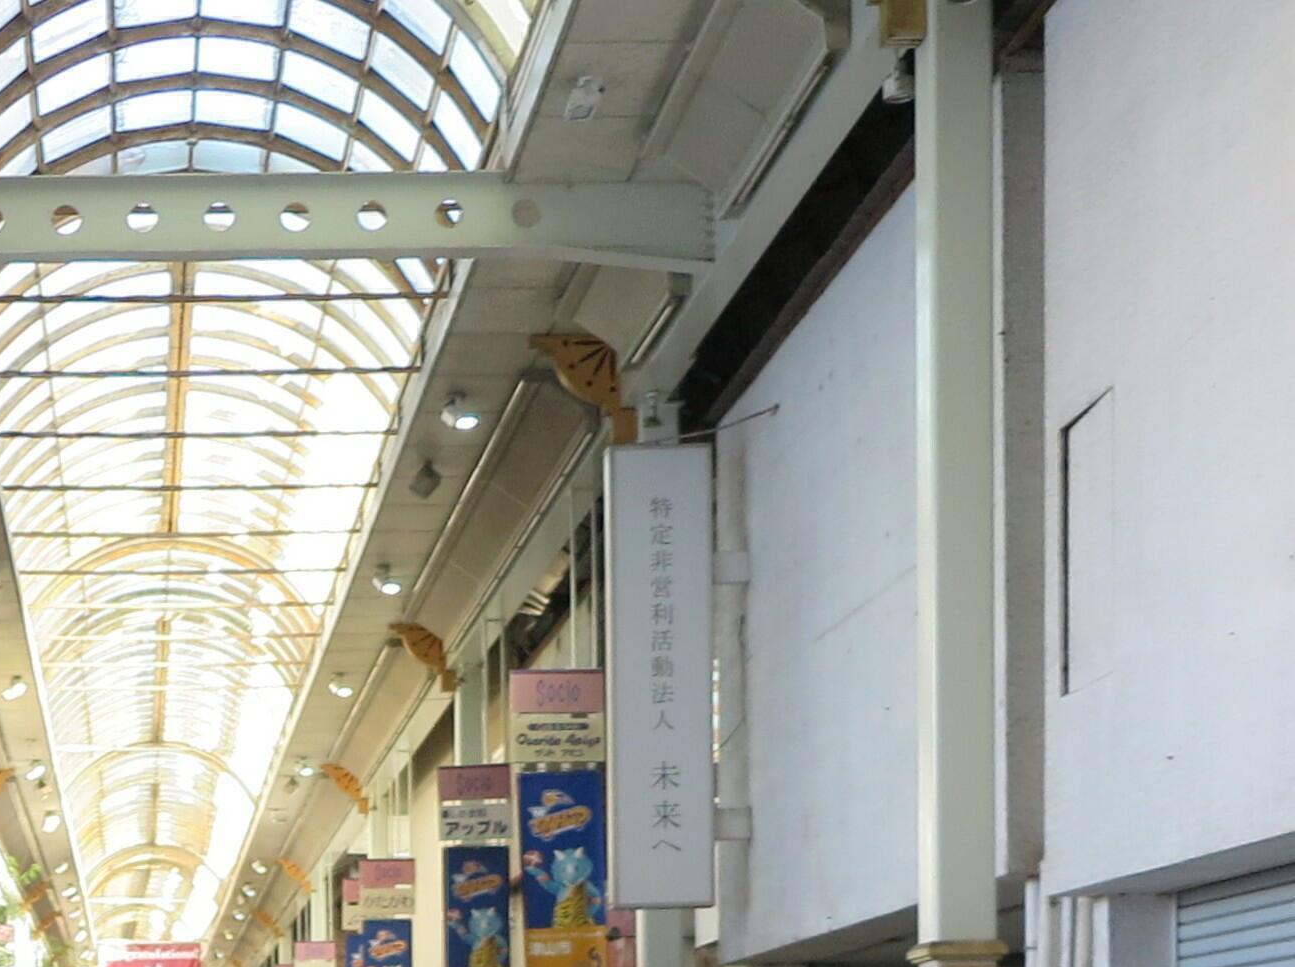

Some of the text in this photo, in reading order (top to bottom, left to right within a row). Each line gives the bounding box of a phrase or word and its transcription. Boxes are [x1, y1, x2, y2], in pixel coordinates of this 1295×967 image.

[648, 496, 682, 853] 特定非営利活動法人 未来へ
[445, 820, 508, 837] アップル
